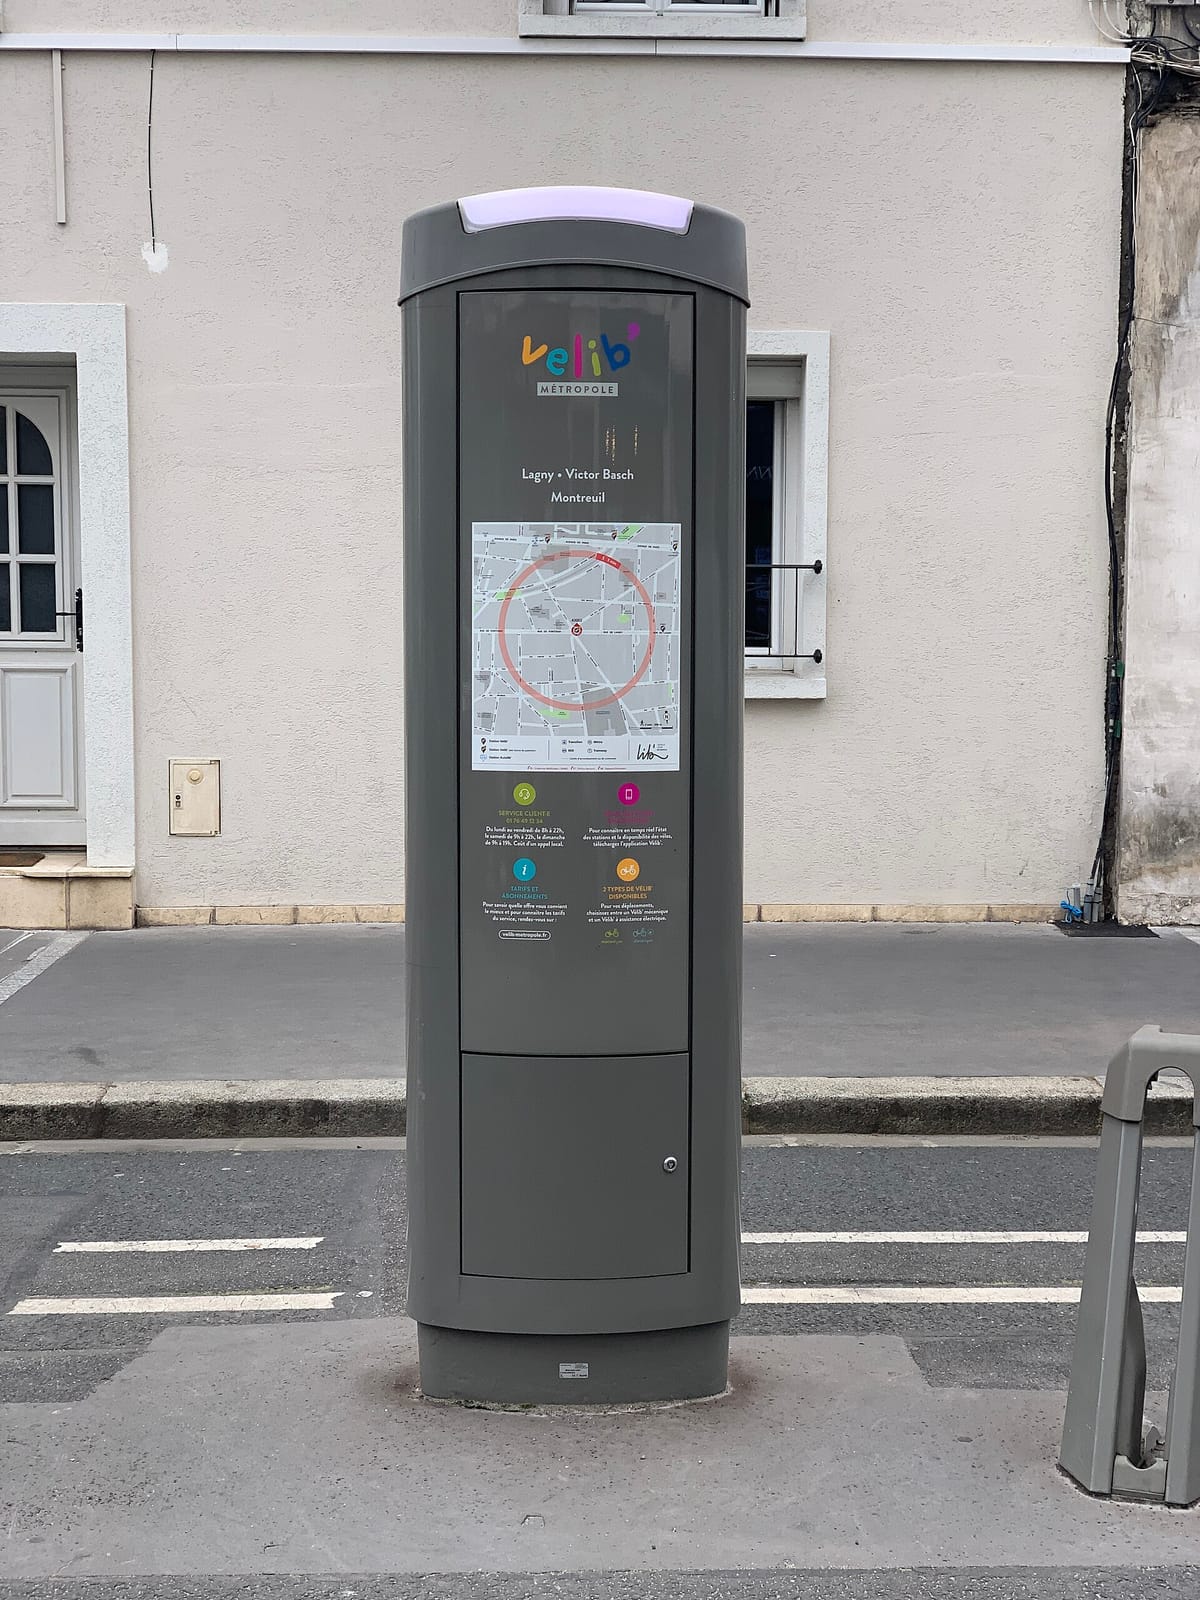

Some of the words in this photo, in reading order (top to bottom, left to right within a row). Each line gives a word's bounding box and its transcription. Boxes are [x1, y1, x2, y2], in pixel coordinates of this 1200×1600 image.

[540, 384, 614, 394] MÉTROPOLE
[522, 468, 554, 483] Lagny
[565, 468, 600, 479] Victor
[603, 469, 634, 480] Basch
[551, 492, 605, 503] Montreuil
